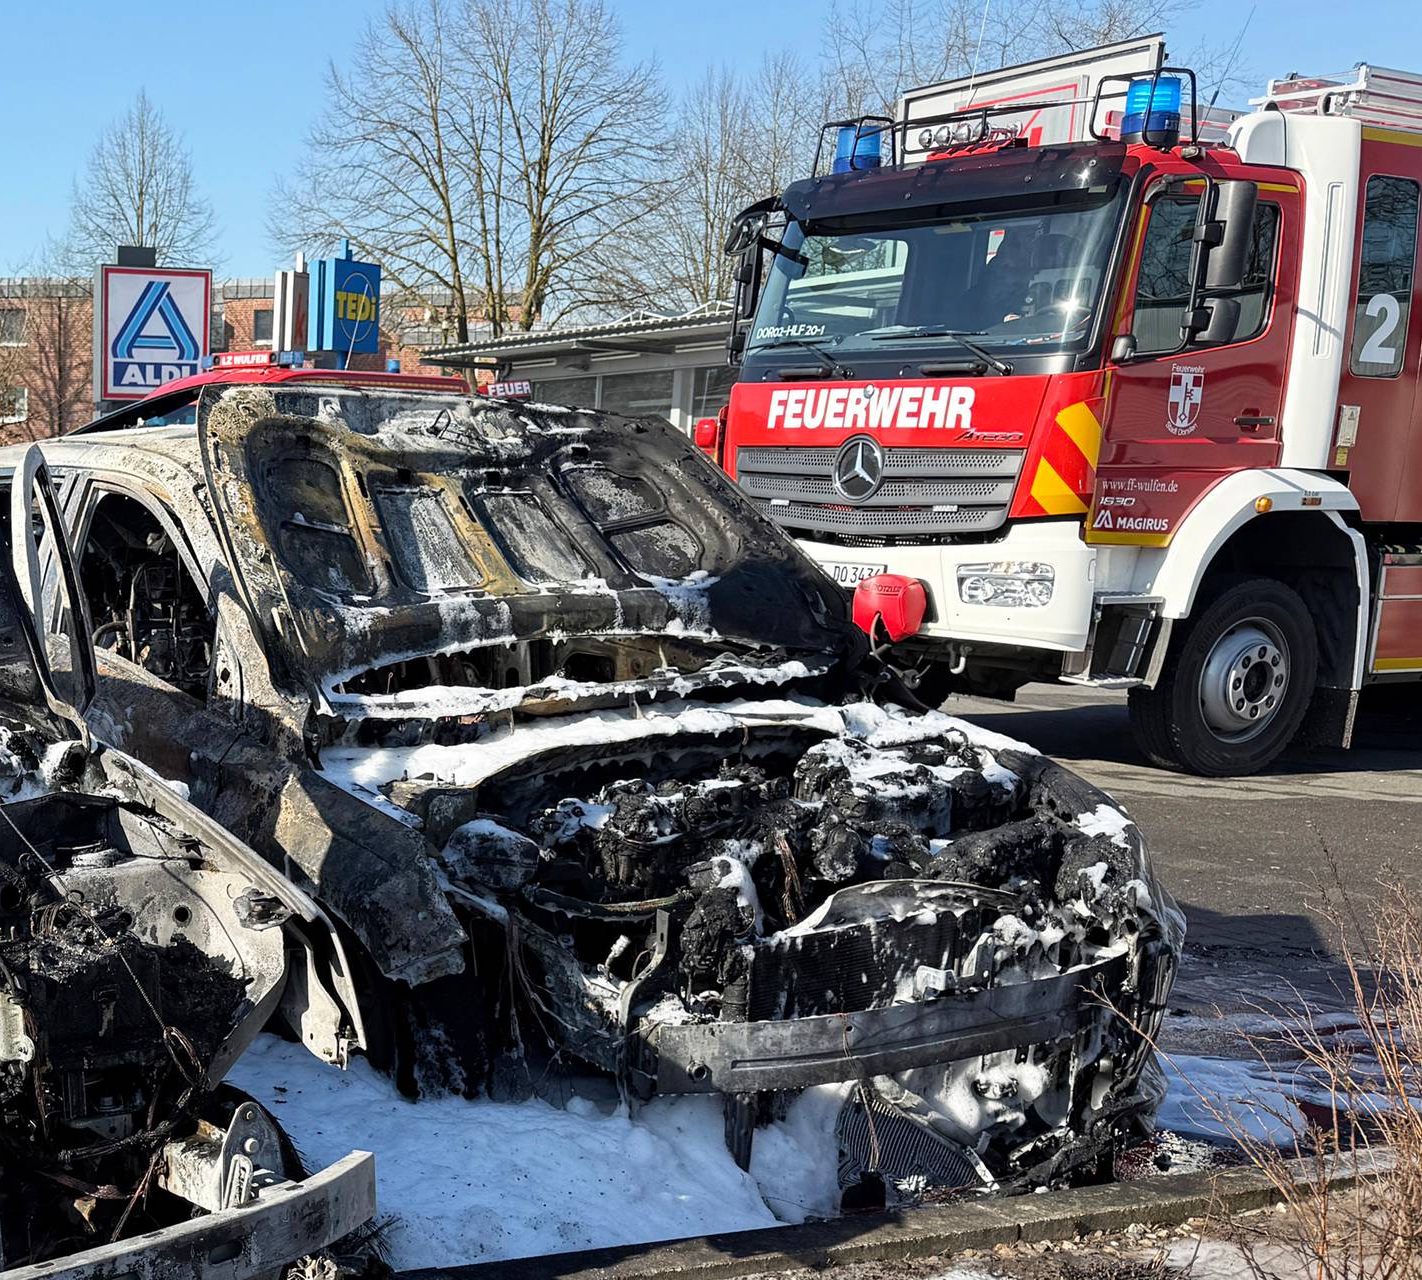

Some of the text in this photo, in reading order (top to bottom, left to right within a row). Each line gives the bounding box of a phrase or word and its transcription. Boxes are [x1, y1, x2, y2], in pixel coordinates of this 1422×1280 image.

[336, 290, 376, 322] TEDi
[805, 325, 826, 336] 20-1
[1359, 293, 1400, 364] 2
[221, 354, 268, 366] LZ WULFEN
[120, 364, 191, 385] ALDI
[1171, 363, 1206, 374] Feuerwehr
[488, 381, 531, 397] FEUER
[767, 386, 975, 429] FEUERWEHR
[1102, 478, 1178, 493] www.ff-wulfen.de
[1116, 517, 1169, 531] MAGIRUS
